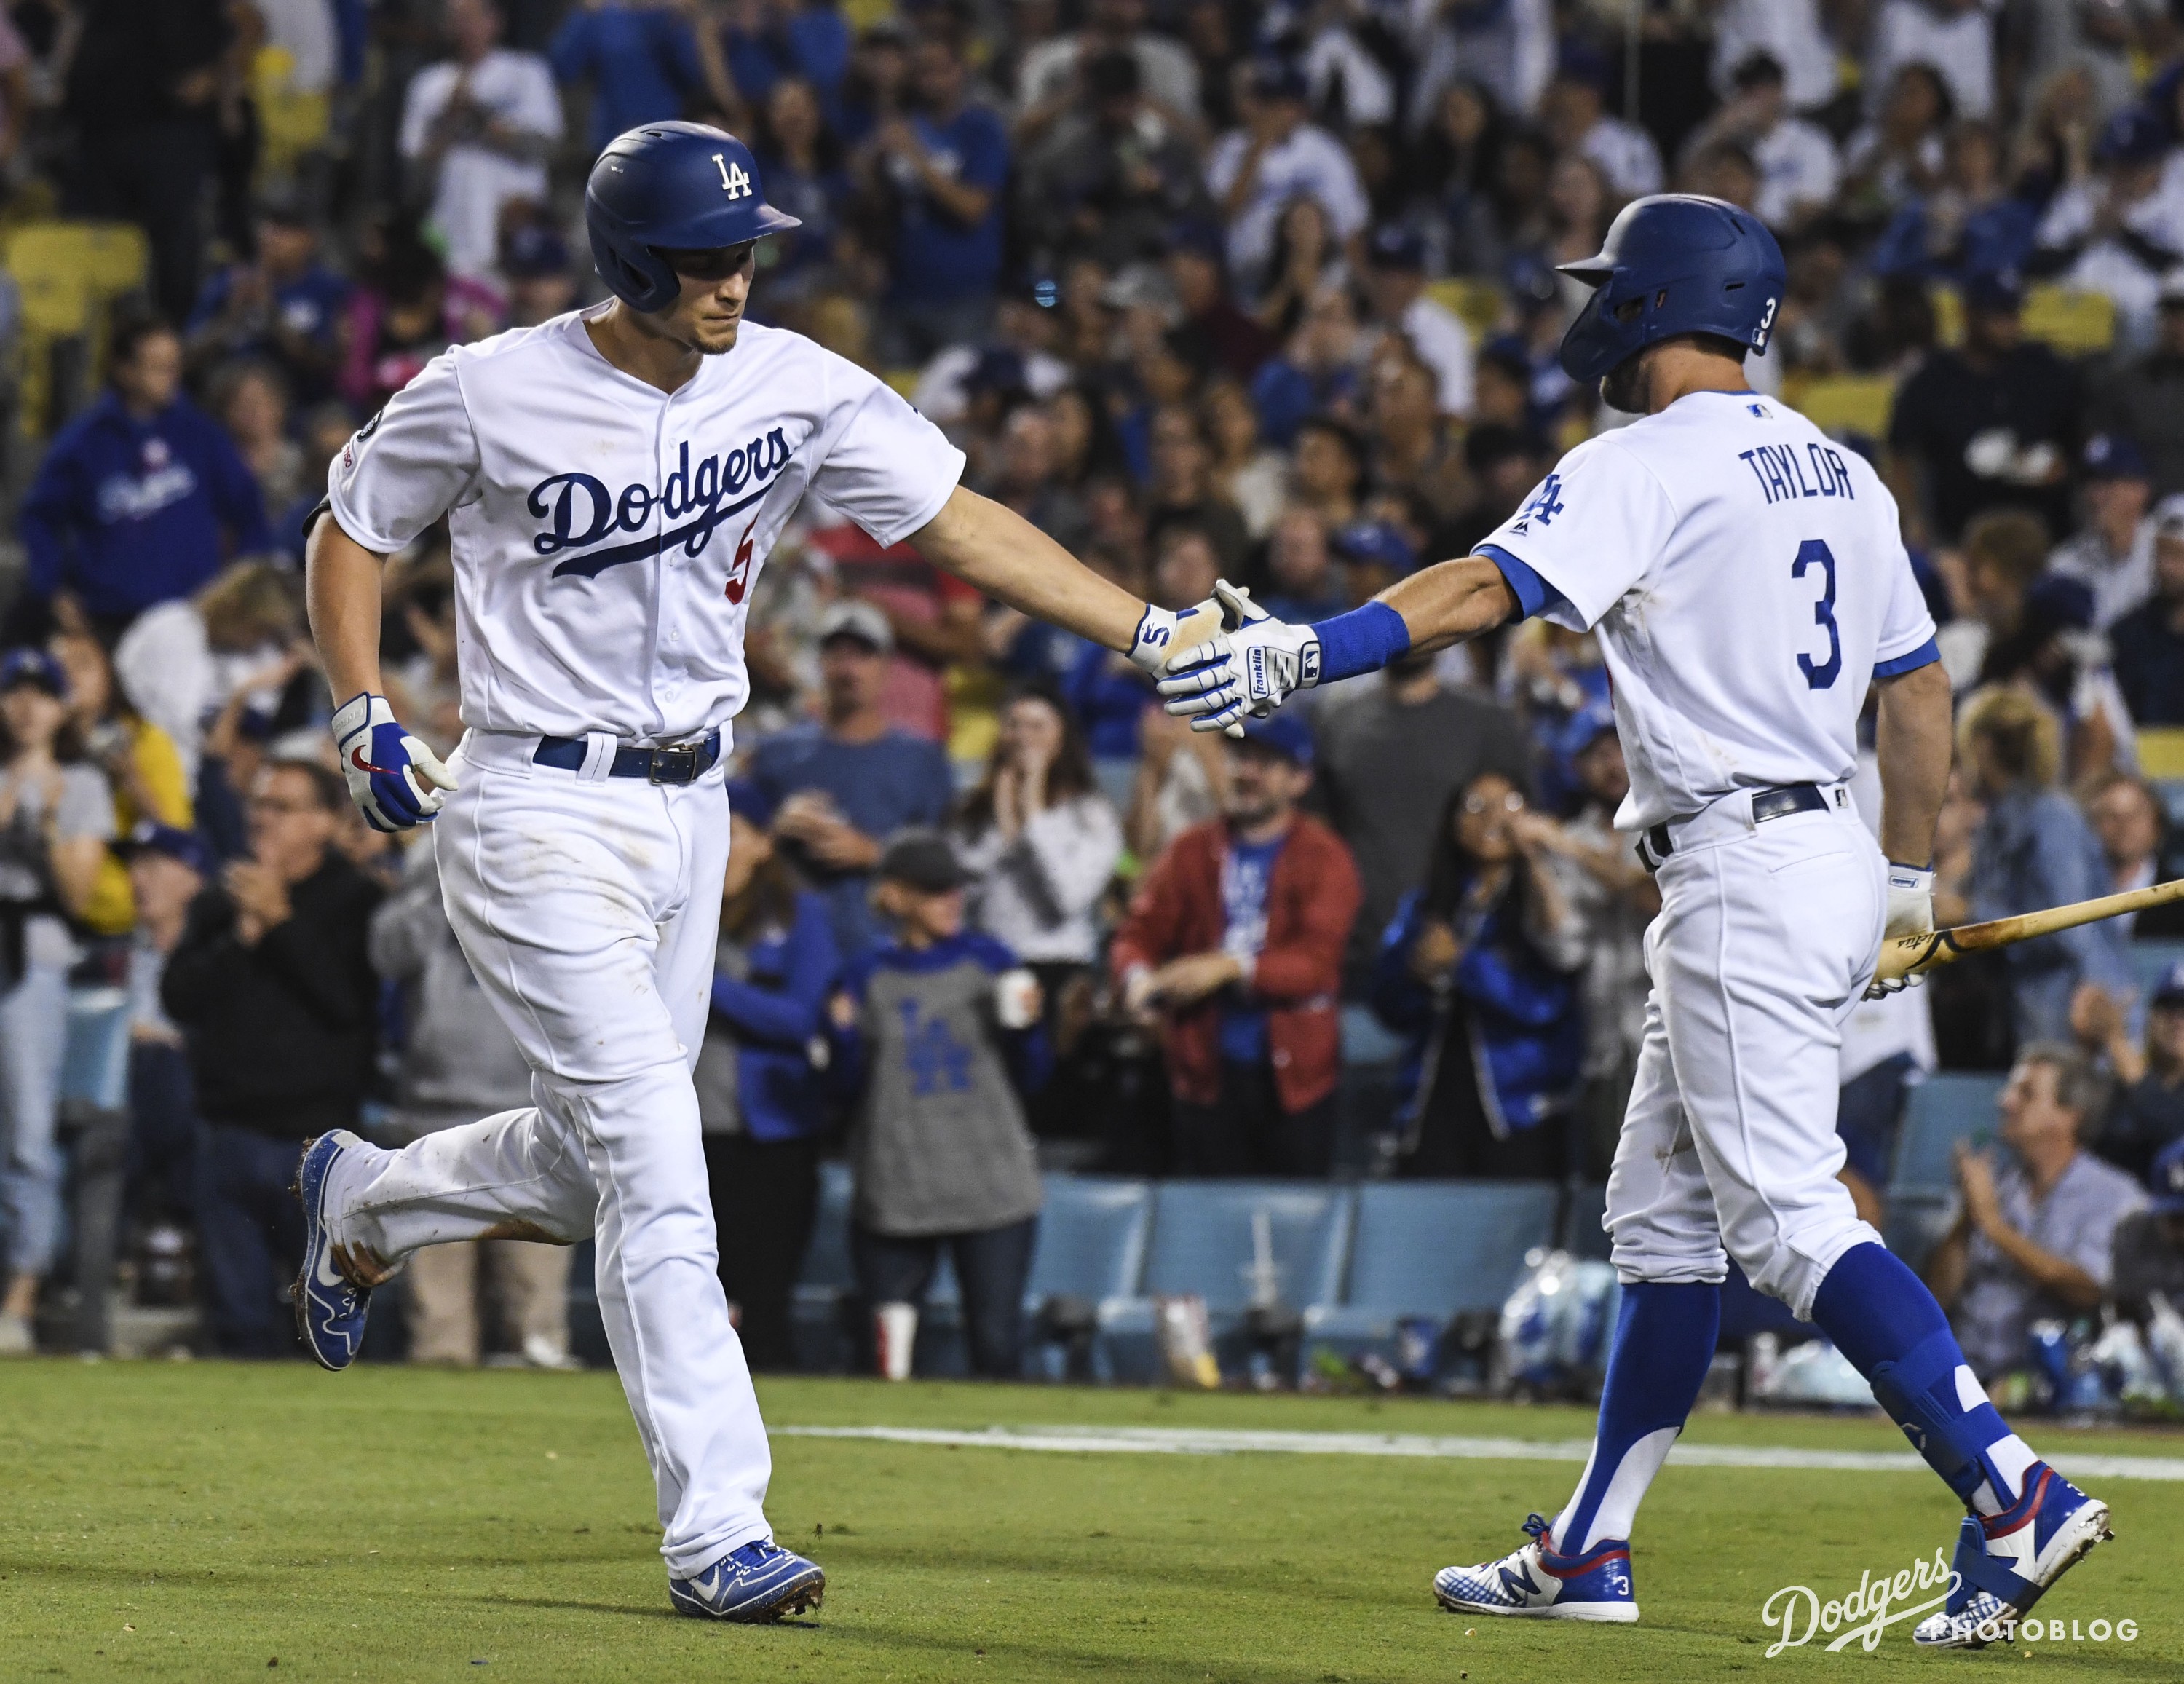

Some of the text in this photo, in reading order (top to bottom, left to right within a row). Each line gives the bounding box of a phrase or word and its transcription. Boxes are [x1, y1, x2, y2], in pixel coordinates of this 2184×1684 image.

[711, 153, 753, 200] LA
[1760, 297, 1776, 330] 3
[527, 427, 792, 559] Dodgers
[1738, 443, 1855, 505] TAYLOR
[725, 514, 759, 605] 5
[1142, 622, 1171, 648] 5
[1791, 539, 1842, 690] 3
[1252, 649, 1267, 695] Franklin
[1613, 1575, 1629, 1596] 3
